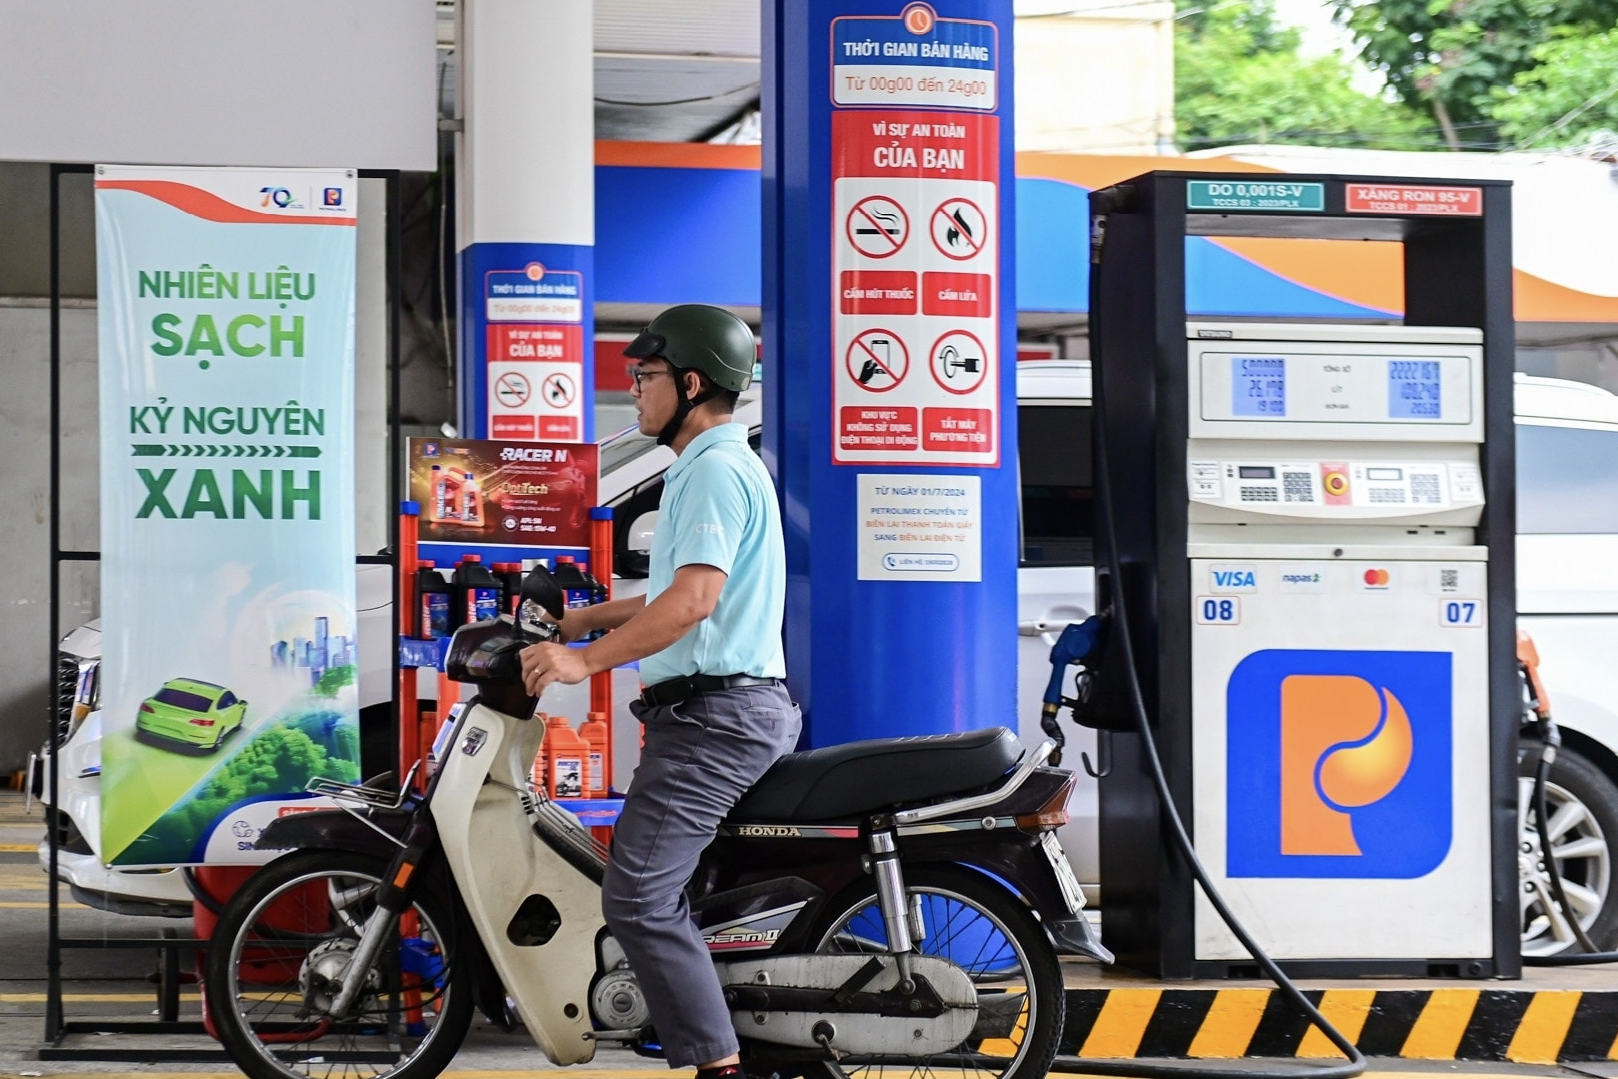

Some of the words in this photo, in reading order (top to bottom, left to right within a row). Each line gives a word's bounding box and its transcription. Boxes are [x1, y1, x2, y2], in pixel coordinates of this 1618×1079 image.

[843, 39, 880, 56] THỜI
[884, 42, 918, 56] GIAN
[921, 41, 950, 58] BÁN
[953, 42, 988, 61] HÀNG
[846, 76, 865, 90] Từ
[870, 77, 913, 93] 00g00
[918, 77, 944, 92] đến
[948, 80, 986, 96] 24g00
[873, 121, 886, 136] VÌ
[888, 124, 910, 138] SỰ
[912, 124, 930, 136] AN
[932, 122, 966, 138] TOÀN
[874, 141, 917, 168] CỦA
[923, 149, 964, 172] BẠN
[1208, 184, 1233, 196] DO
[1236, 184, 1303, 198] 0,001S-V
[1358, 188, 1400, 200] XĂNG
[1402, 190, 1436, 202] RON
[1438, 192, 1470, 202] 95-V
[1212, 198, 1238, 206] TCCS
[138, 264, 238, 298] NHIÊN
[248, 265, 316, 309] LIỆU
[844, 287, 864, 298] CẤM
[938, 288, 958, 300] CẤM
[151, 313, 305, 370] SẠCH
[130, 397, 174, 434] KỶ
[184, 400, 324, 436] NGUYÊN
[500, 448, 554, 462] RACER
[554, 449, 568, 462] N
[135, 469, 321, 520] XANH
[892, 486, 918, 496] NGÀY
[1212, 572, 1256, 586] VISA
[1204, 600, 1232, 620] 08
[1447, 602, 1476, 622] 07
[738, 827, 802, 836] HONDA
[702, 932, 763, 944] REAM
